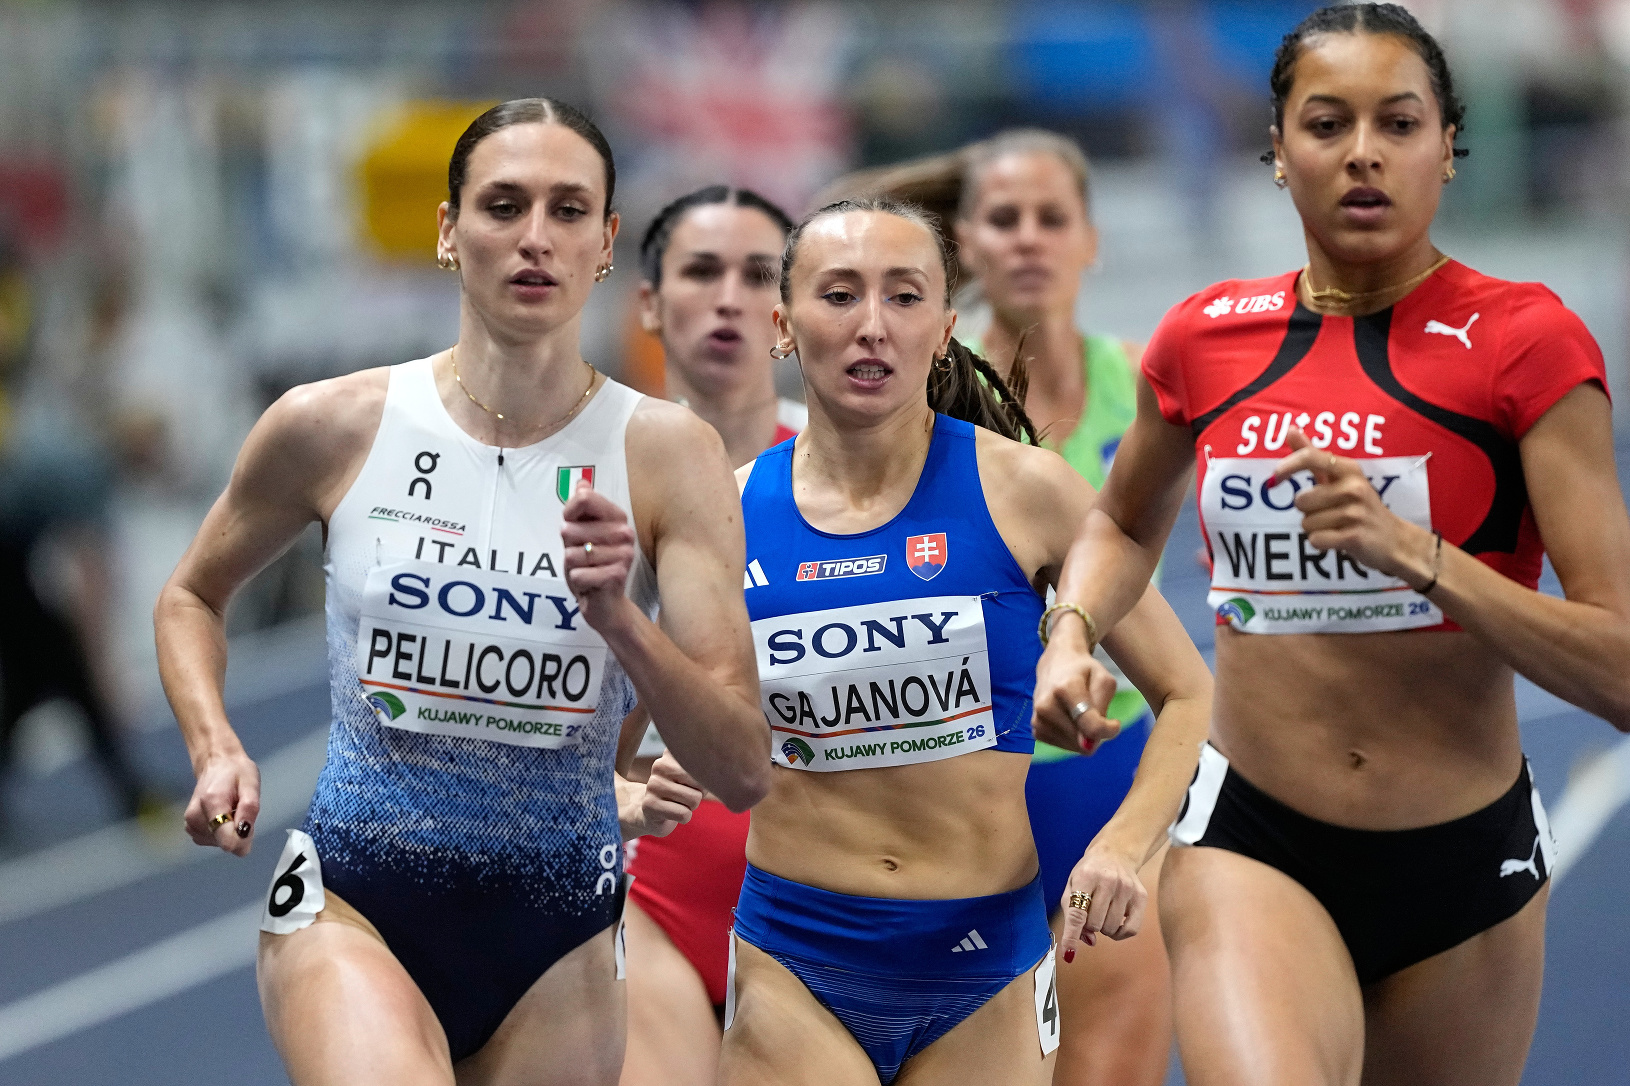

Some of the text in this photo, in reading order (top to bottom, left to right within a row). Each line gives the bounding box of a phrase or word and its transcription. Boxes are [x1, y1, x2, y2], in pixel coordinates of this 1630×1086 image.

[1234, 290, 1287, 315] UBS
[1219, 473, 1401, 512] SO
[369, 505, 467, 533] FRECCIAROSSA
[414, 536, 558, 578] ITALIA
[822, 558, 882, 577] TIPOS
[1218, 530, 1384, 581] WERR
[387, 572, 581, 631] SONY
[1262, 600, 1430, 621] KUJAWY POMORZE 26
[767, 611, 959, 667] SONY
[365, 627, 591, 703] PELLICORO
[768, 656, 981, 729] GAJANOVÁ
[417, 706, 483, 726] KUJAWY
[486, 716, 564, 737] POMORZE
[824, 724, 986, 761] KUJAWY POMORZE 26
[267, 851, 308, 918] 6
[1042, 964, 1058, 1037] 4
